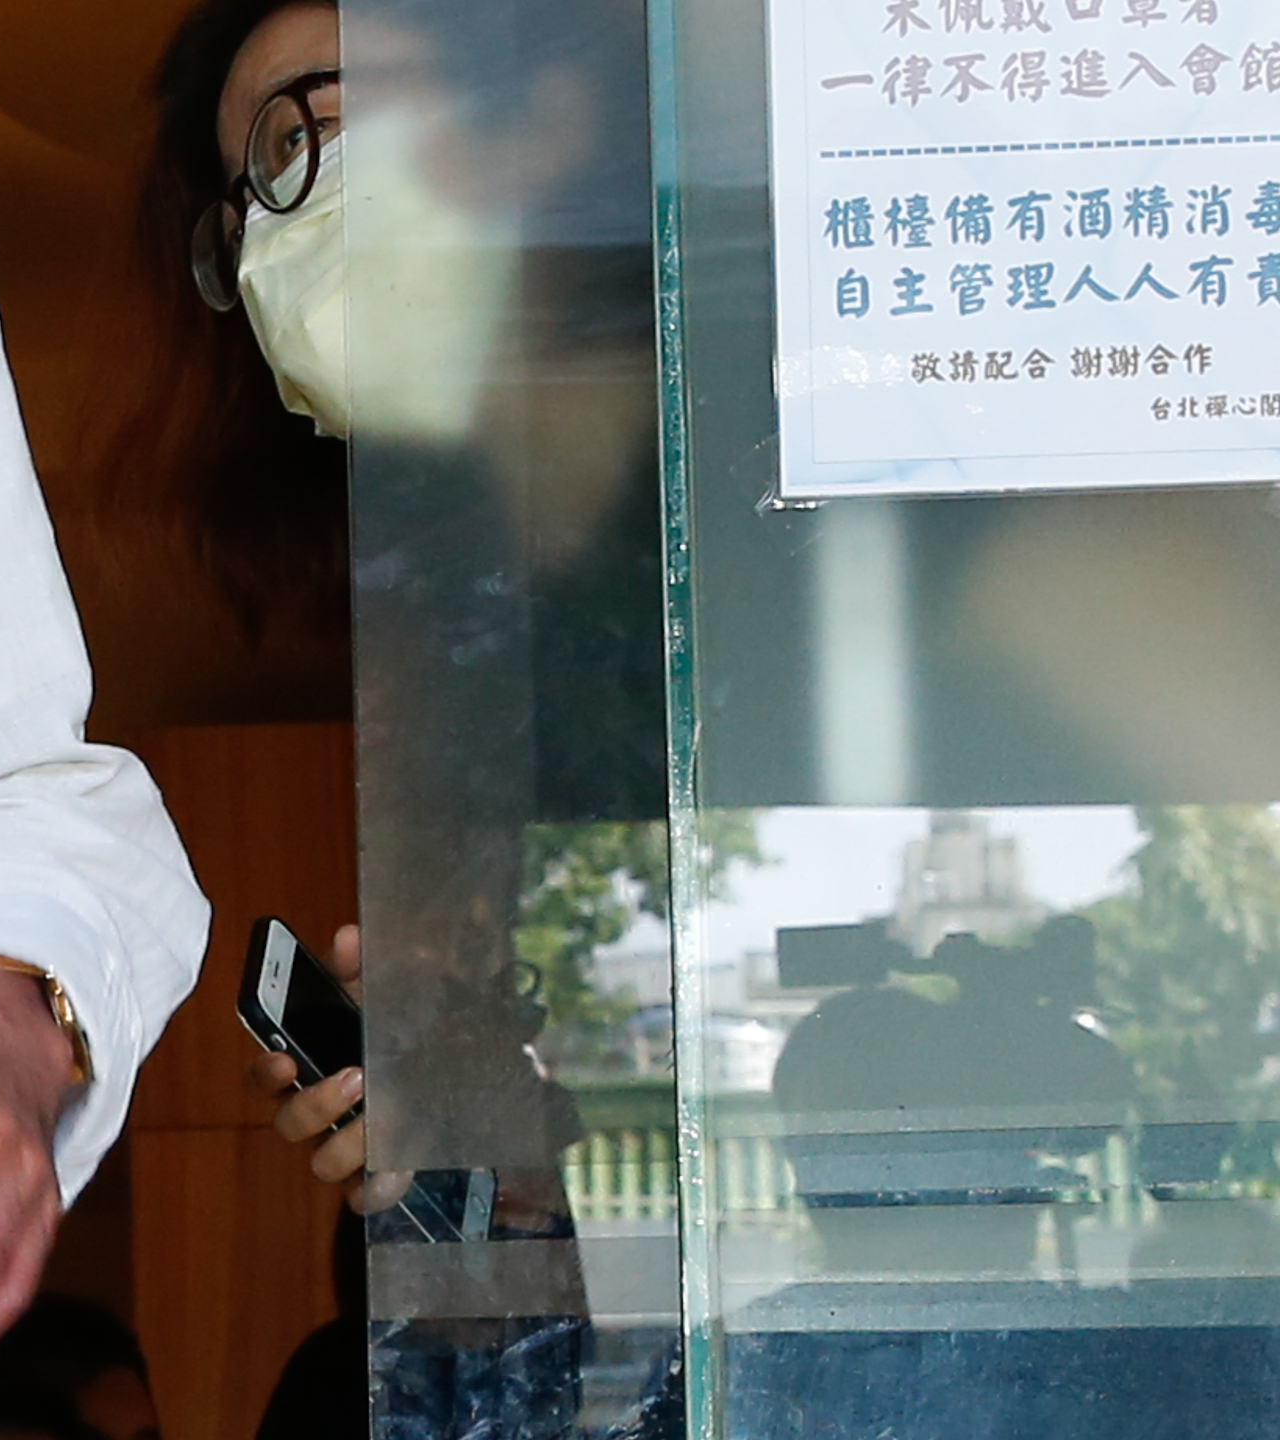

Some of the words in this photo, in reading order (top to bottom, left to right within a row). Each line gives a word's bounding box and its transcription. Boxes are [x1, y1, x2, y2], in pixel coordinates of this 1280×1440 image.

[820, 42, 1279, 107] 一律不得進入會館
[835, 252, 1279, 319] 自主管理人人有責
